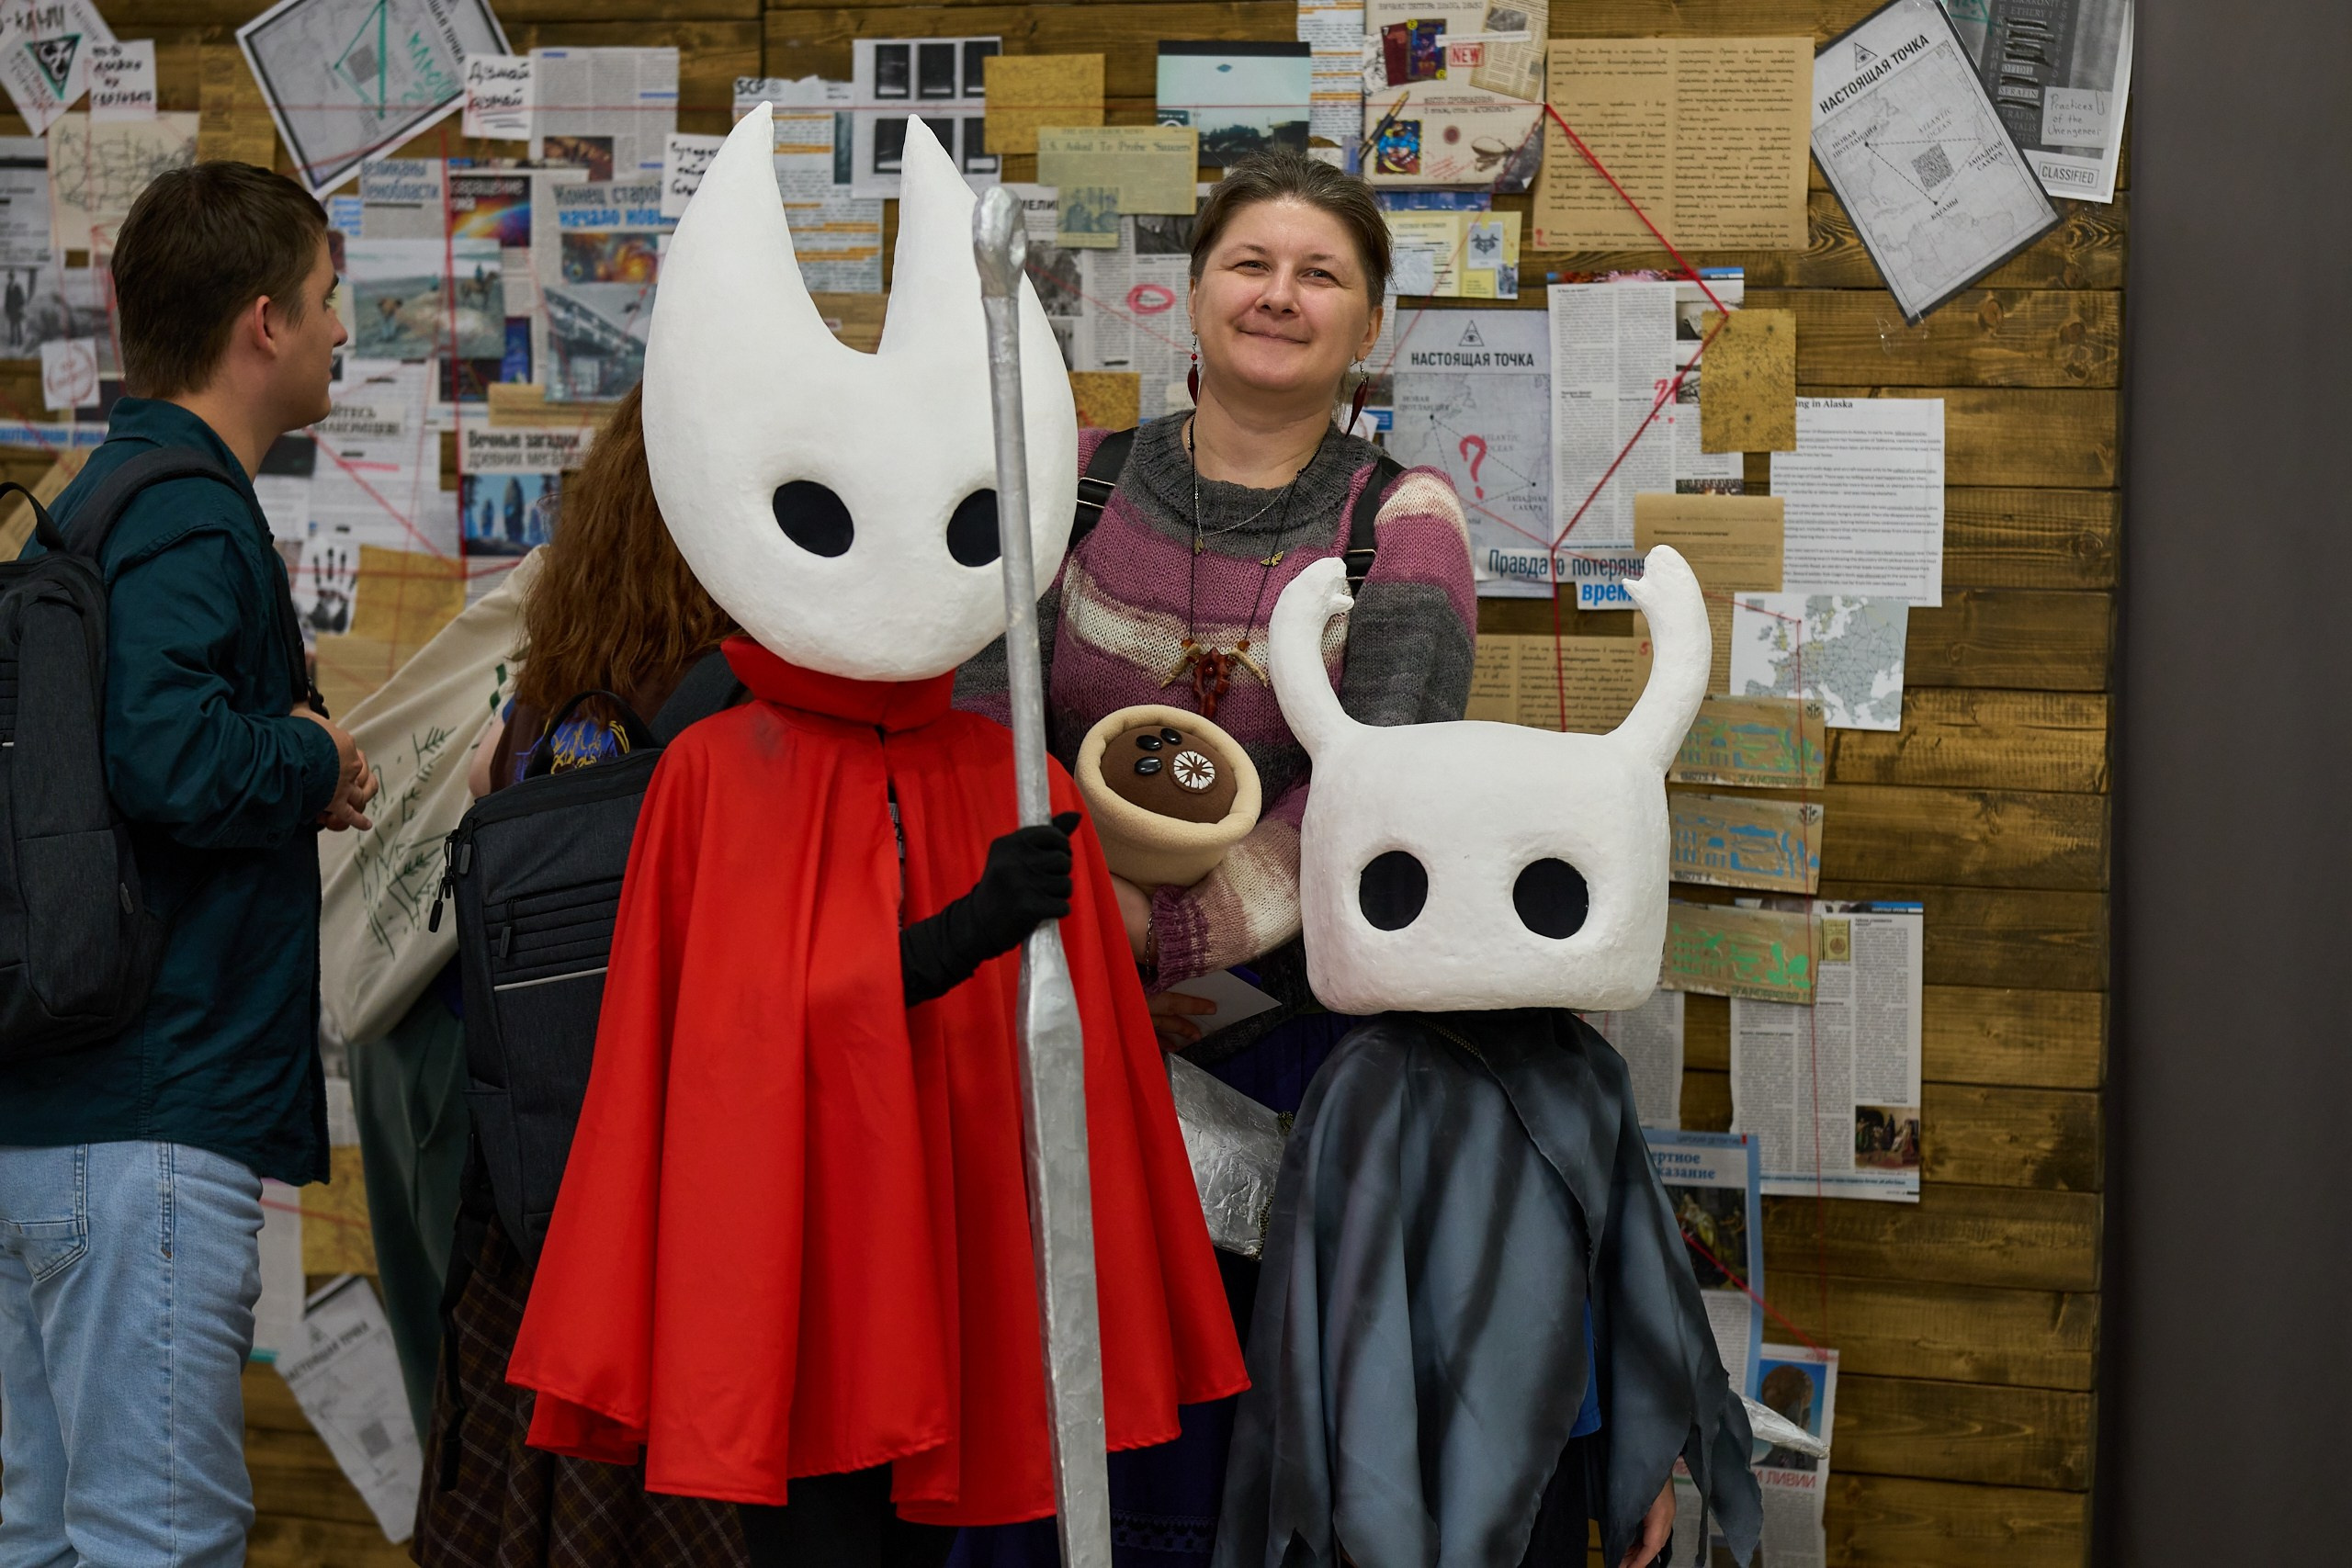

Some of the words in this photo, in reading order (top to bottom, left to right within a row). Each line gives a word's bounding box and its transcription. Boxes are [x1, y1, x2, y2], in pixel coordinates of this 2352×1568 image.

[1452, 46, 1480, 64] NEW
[1819, 59, 1892, 114] НАСТОЯЩАЯ
[1890, 34, 1929, 65] ТОЧКА
[2041, 165, 2095, 185] CLASSIFIED
[1410, 353, 1490, 368] НАСТОЯЩАЯ
[1494, 353, 1534, 367] ТОЧКА
[1812, 400, 1821, 408] in
[1823, 400, 1853, 409] Alaska
[1488, 549, 1548, 578] Правда
[1556, 558, 1565, 575] о
[1572, 558, 1645, 581] потерянн
[1582, 583, 1633, 606] врем
[1766, 1471, 1816, 1489] ЛИВИИ
